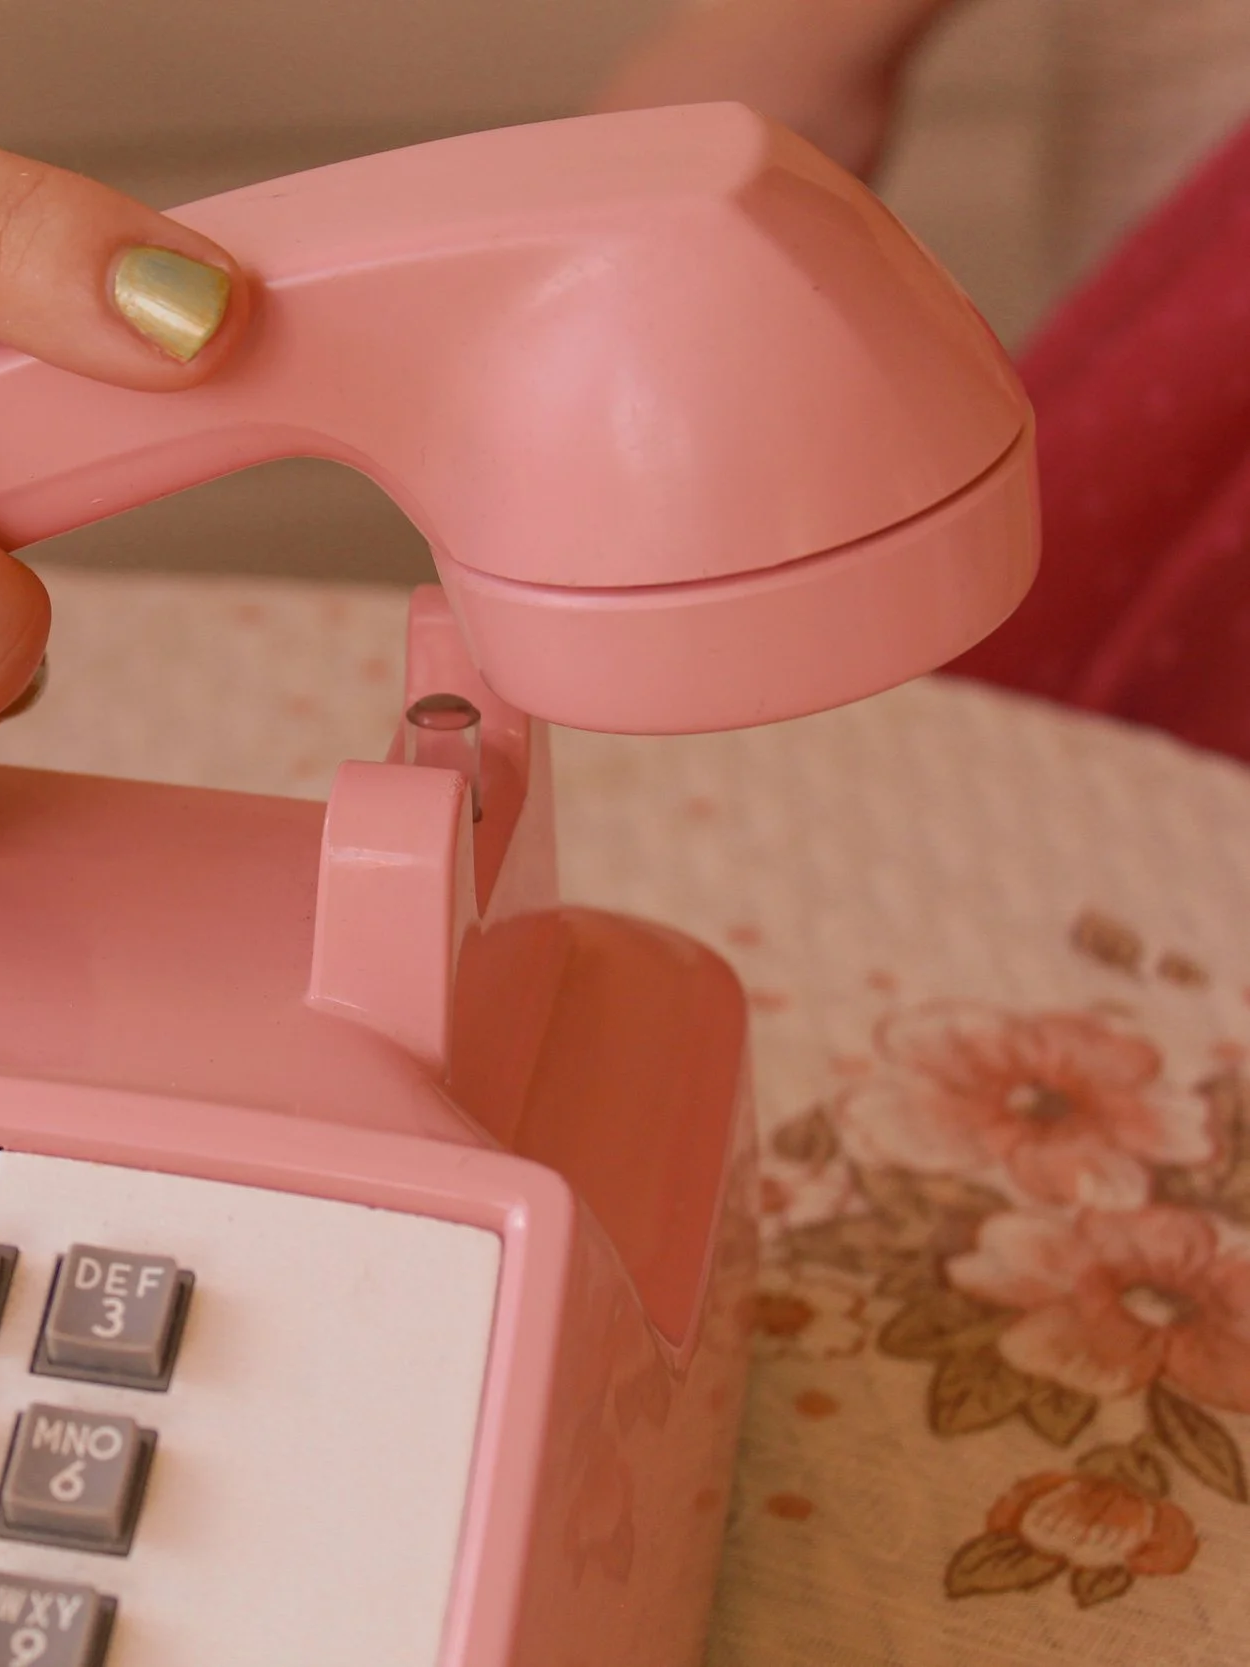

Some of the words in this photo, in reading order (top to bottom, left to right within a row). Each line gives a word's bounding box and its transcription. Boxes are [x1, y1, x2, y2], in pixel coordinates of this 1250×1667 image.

[73, 1256, 166, 1298] DEF
[91, 1300, 125, 1339] 3
[31, 1419, 123, 1460] MNO
[50, 1461, 86, 1501] 6
[9, 1629, 47, 1667] 9
